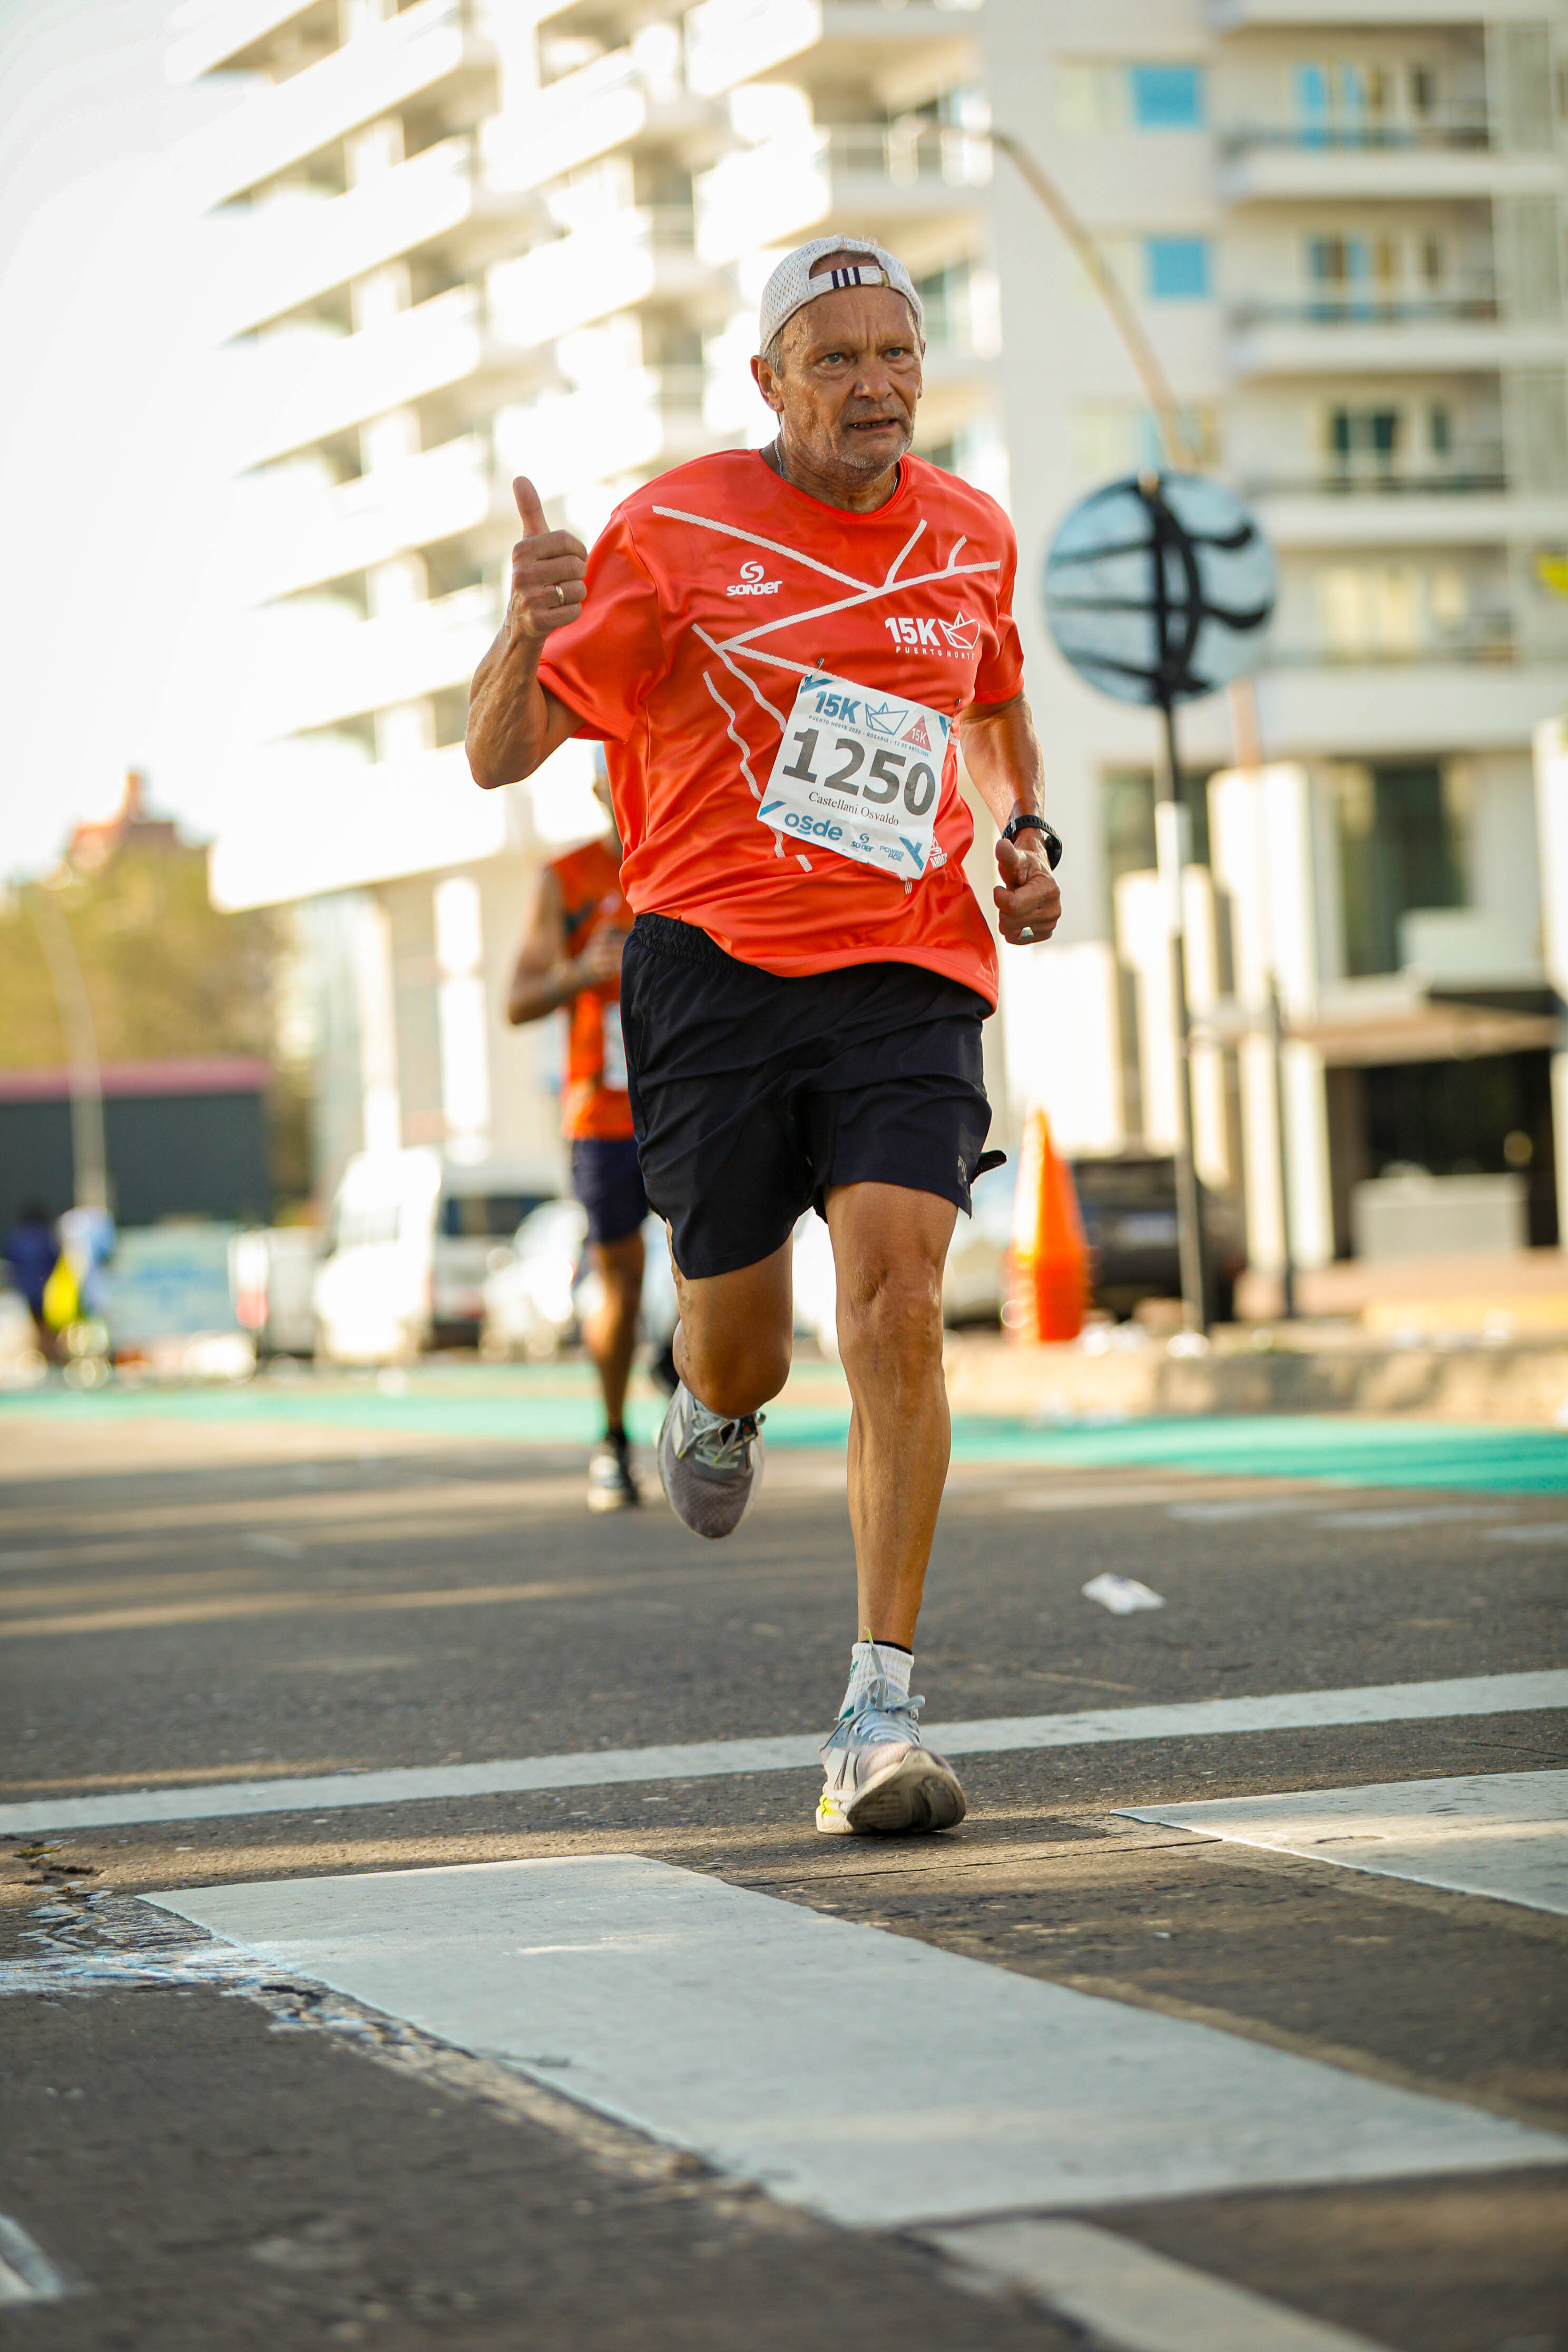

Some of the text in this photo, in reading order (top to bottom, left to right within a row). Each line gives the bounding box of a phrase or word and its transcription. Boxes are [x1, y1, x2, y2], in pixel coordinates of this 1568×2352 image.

[885, 617, 940, 646] 15K
[896, 646, 974, 661] PUERTO NORTE
[815, 691, 861, 724] 15K
[809, 714, 830, 724] PUERTO
[831, 721, 848, 730] NORTE
[867, 732, 889, 742] ROSARIO
[912, 728, 927, 744] 15K
[782, 728, 936, 816] 1250
[809, 791, 899, 826] Castellani Osvaldo
[785, 813, 843, 841] osde
[880, 845, 904, 856] POWER
